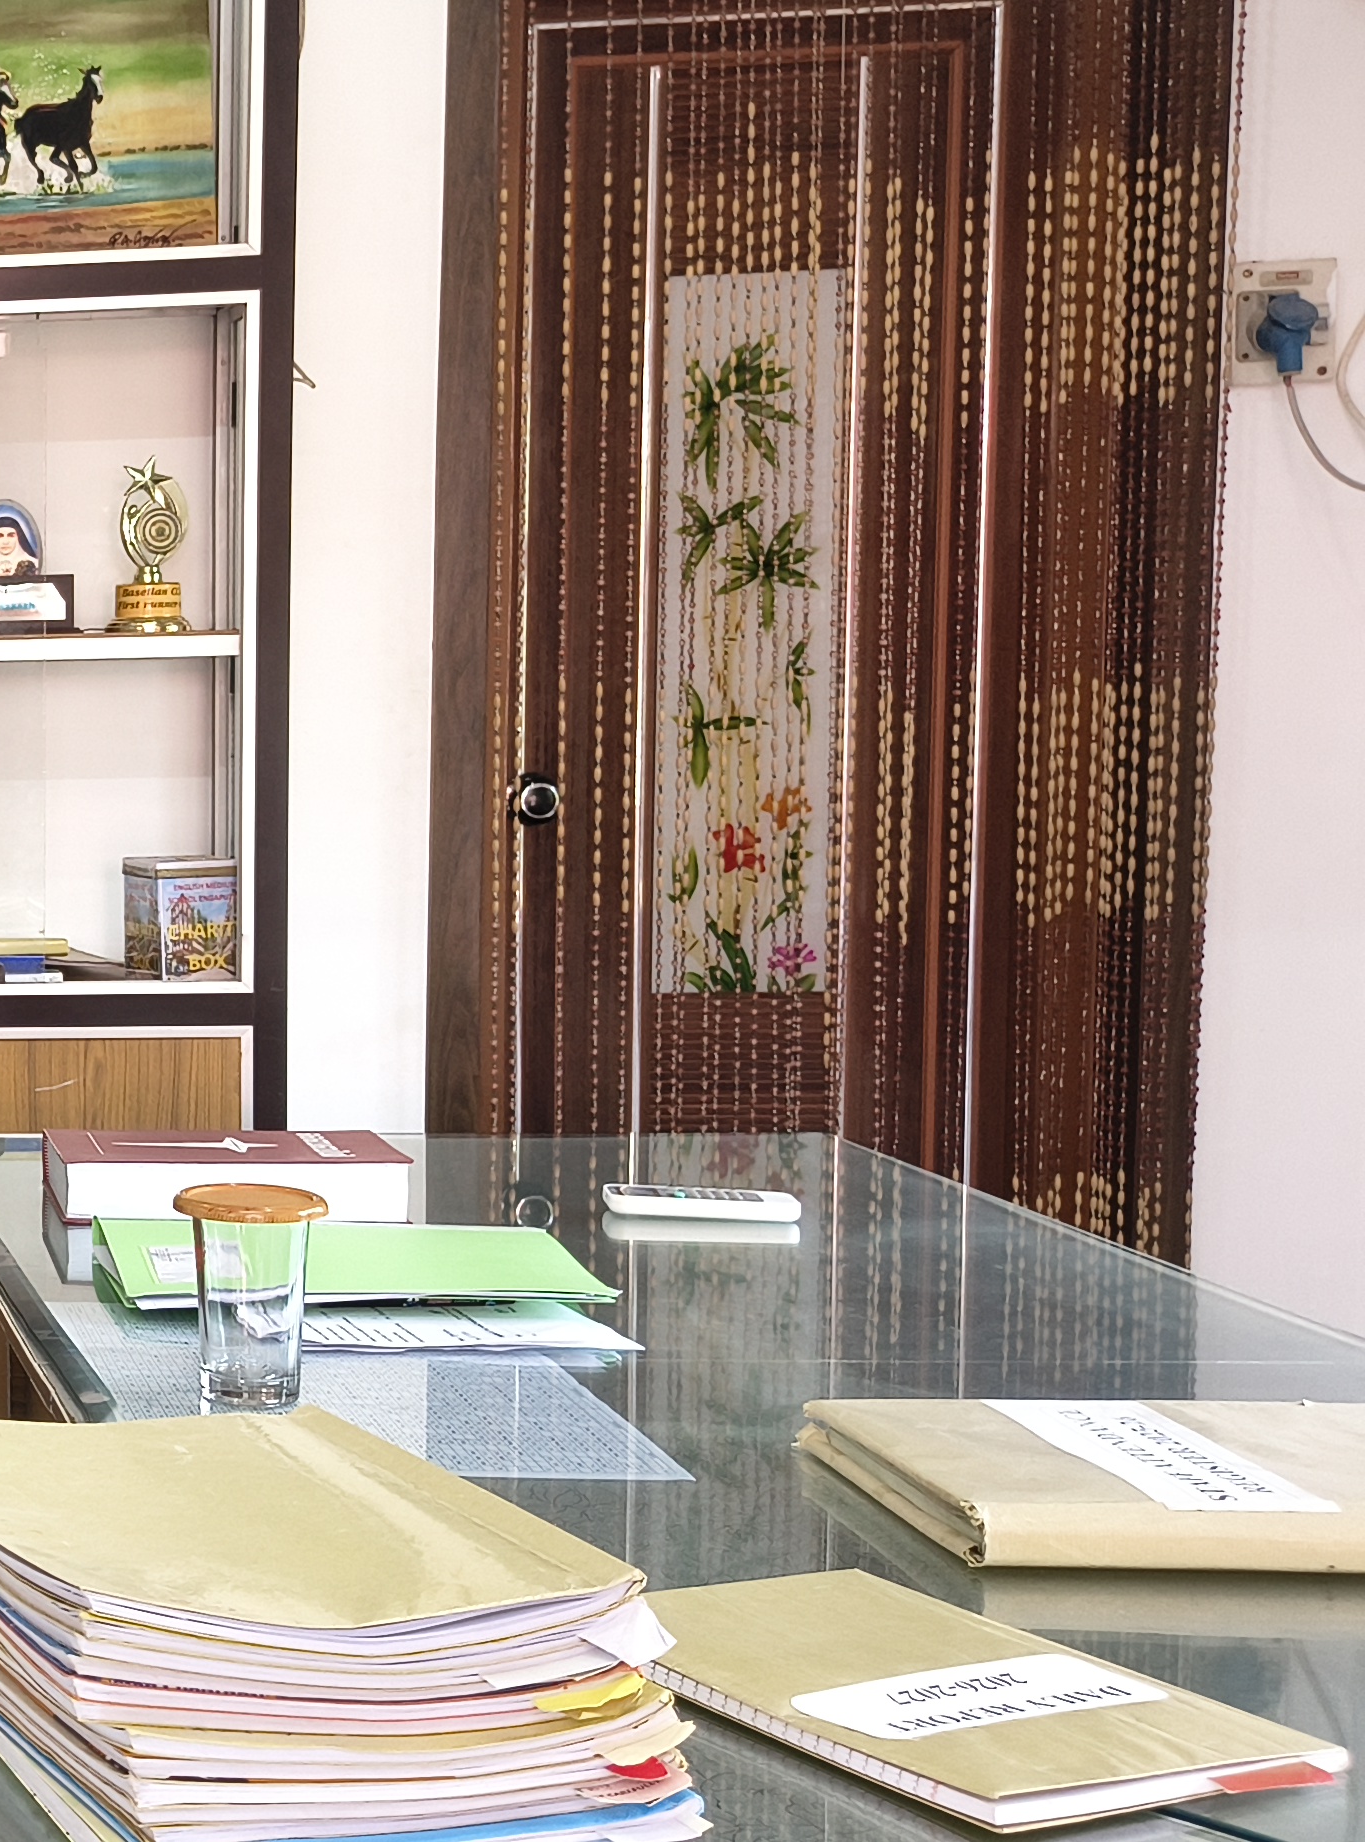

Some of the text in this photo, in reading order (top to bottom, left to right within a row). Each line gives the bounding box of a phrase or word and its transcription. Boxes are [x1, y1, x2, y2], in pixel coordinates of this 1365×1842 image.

[118, 601, 178, 610] First runner
[169, 922, 235, 941] CHARIT
[189, 954, 228, 970] BOX
[1168, 1448, 1274, 1493] REGISTER
[1163, 1471, 1237, 1501] STAFF
[887, 1673, 1027, 1705] 2026-2027
[887, 1686, 1132, 1733] DAILY REPORT
